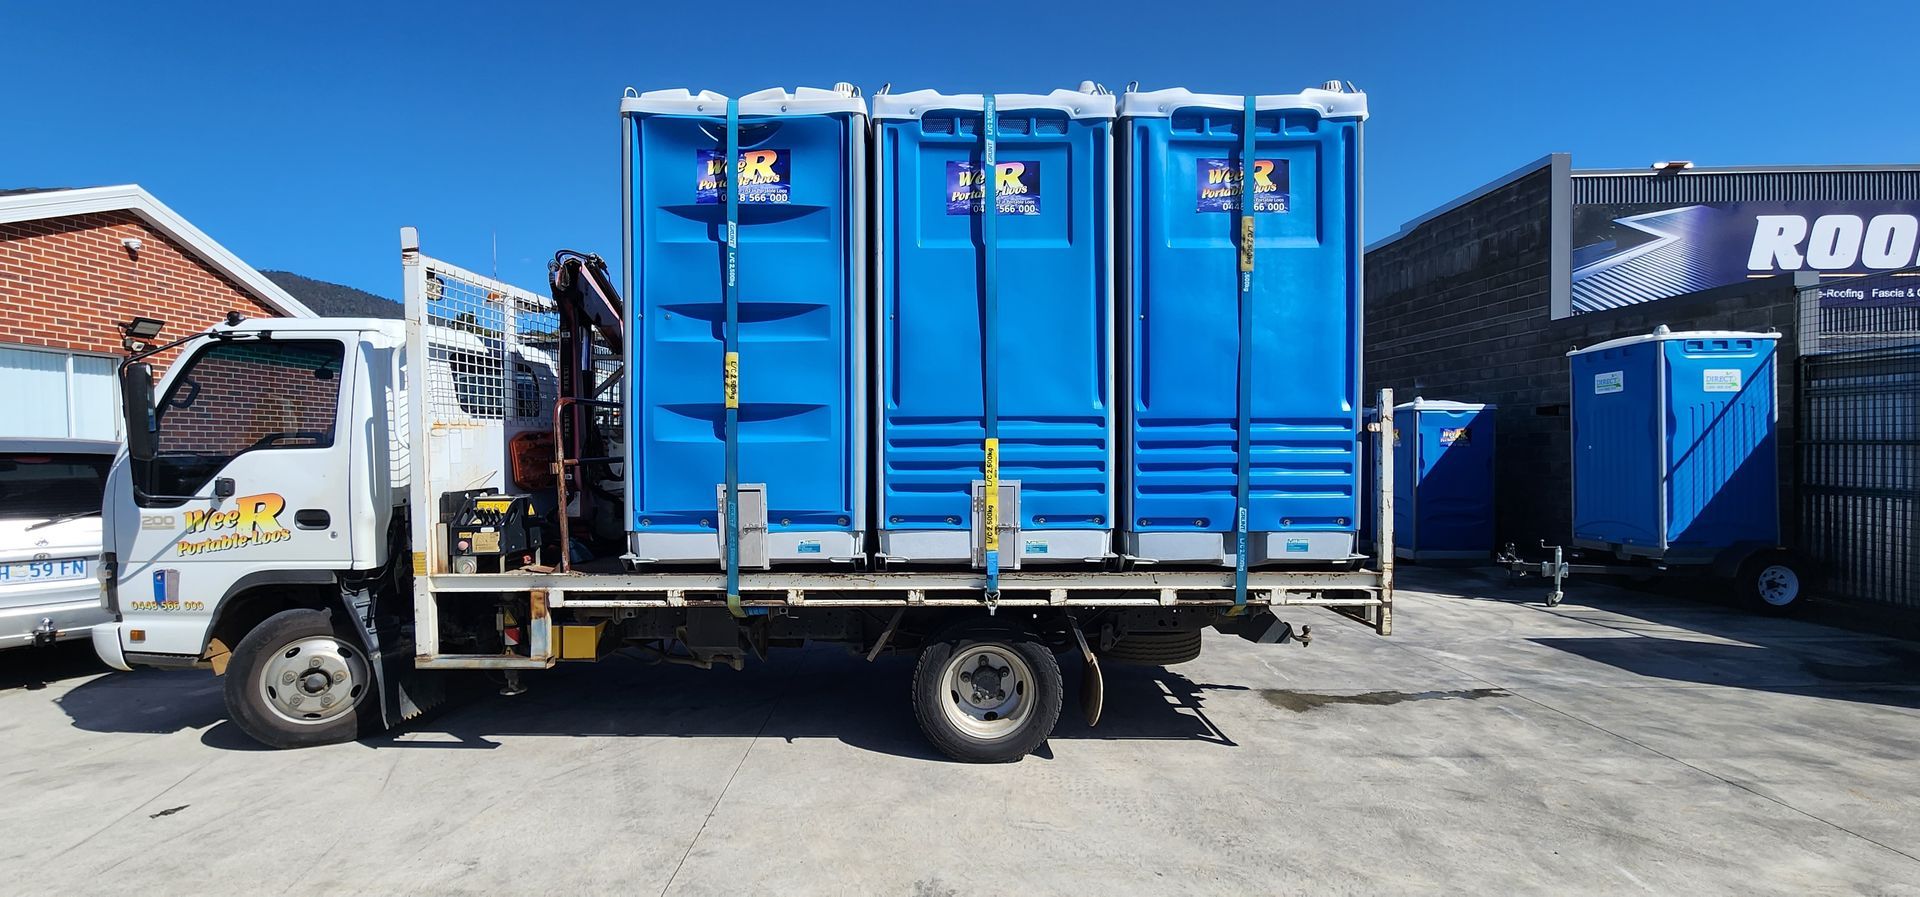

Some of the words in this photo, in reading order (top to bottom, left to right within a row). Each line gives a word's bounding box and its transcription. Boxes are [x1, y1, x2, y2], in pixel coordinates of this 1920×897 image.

[749, 193, 766, 202] 566
[769, 193, 788, 202] 000
[999, 204, 1016, 213] 566
[1018, 204, 1036, 213] 000
[1267, 202, 1285, 211] 000
[1747, 214, 1920, 270] ROO
[1872, 288, 1905, 298] Fascia
[1906, 288, 1915, 298] &
[986, 448, 994, 474] 2,500kg
[141, 515, 176, 526] 200
[986, 505, 994, 531] 2,500kg
[29, 561, 53, 577] 59
[61, 559, 84, 575] FN
[161, 600, 181, 611] 566
[184, 600, 206, 611] 000
